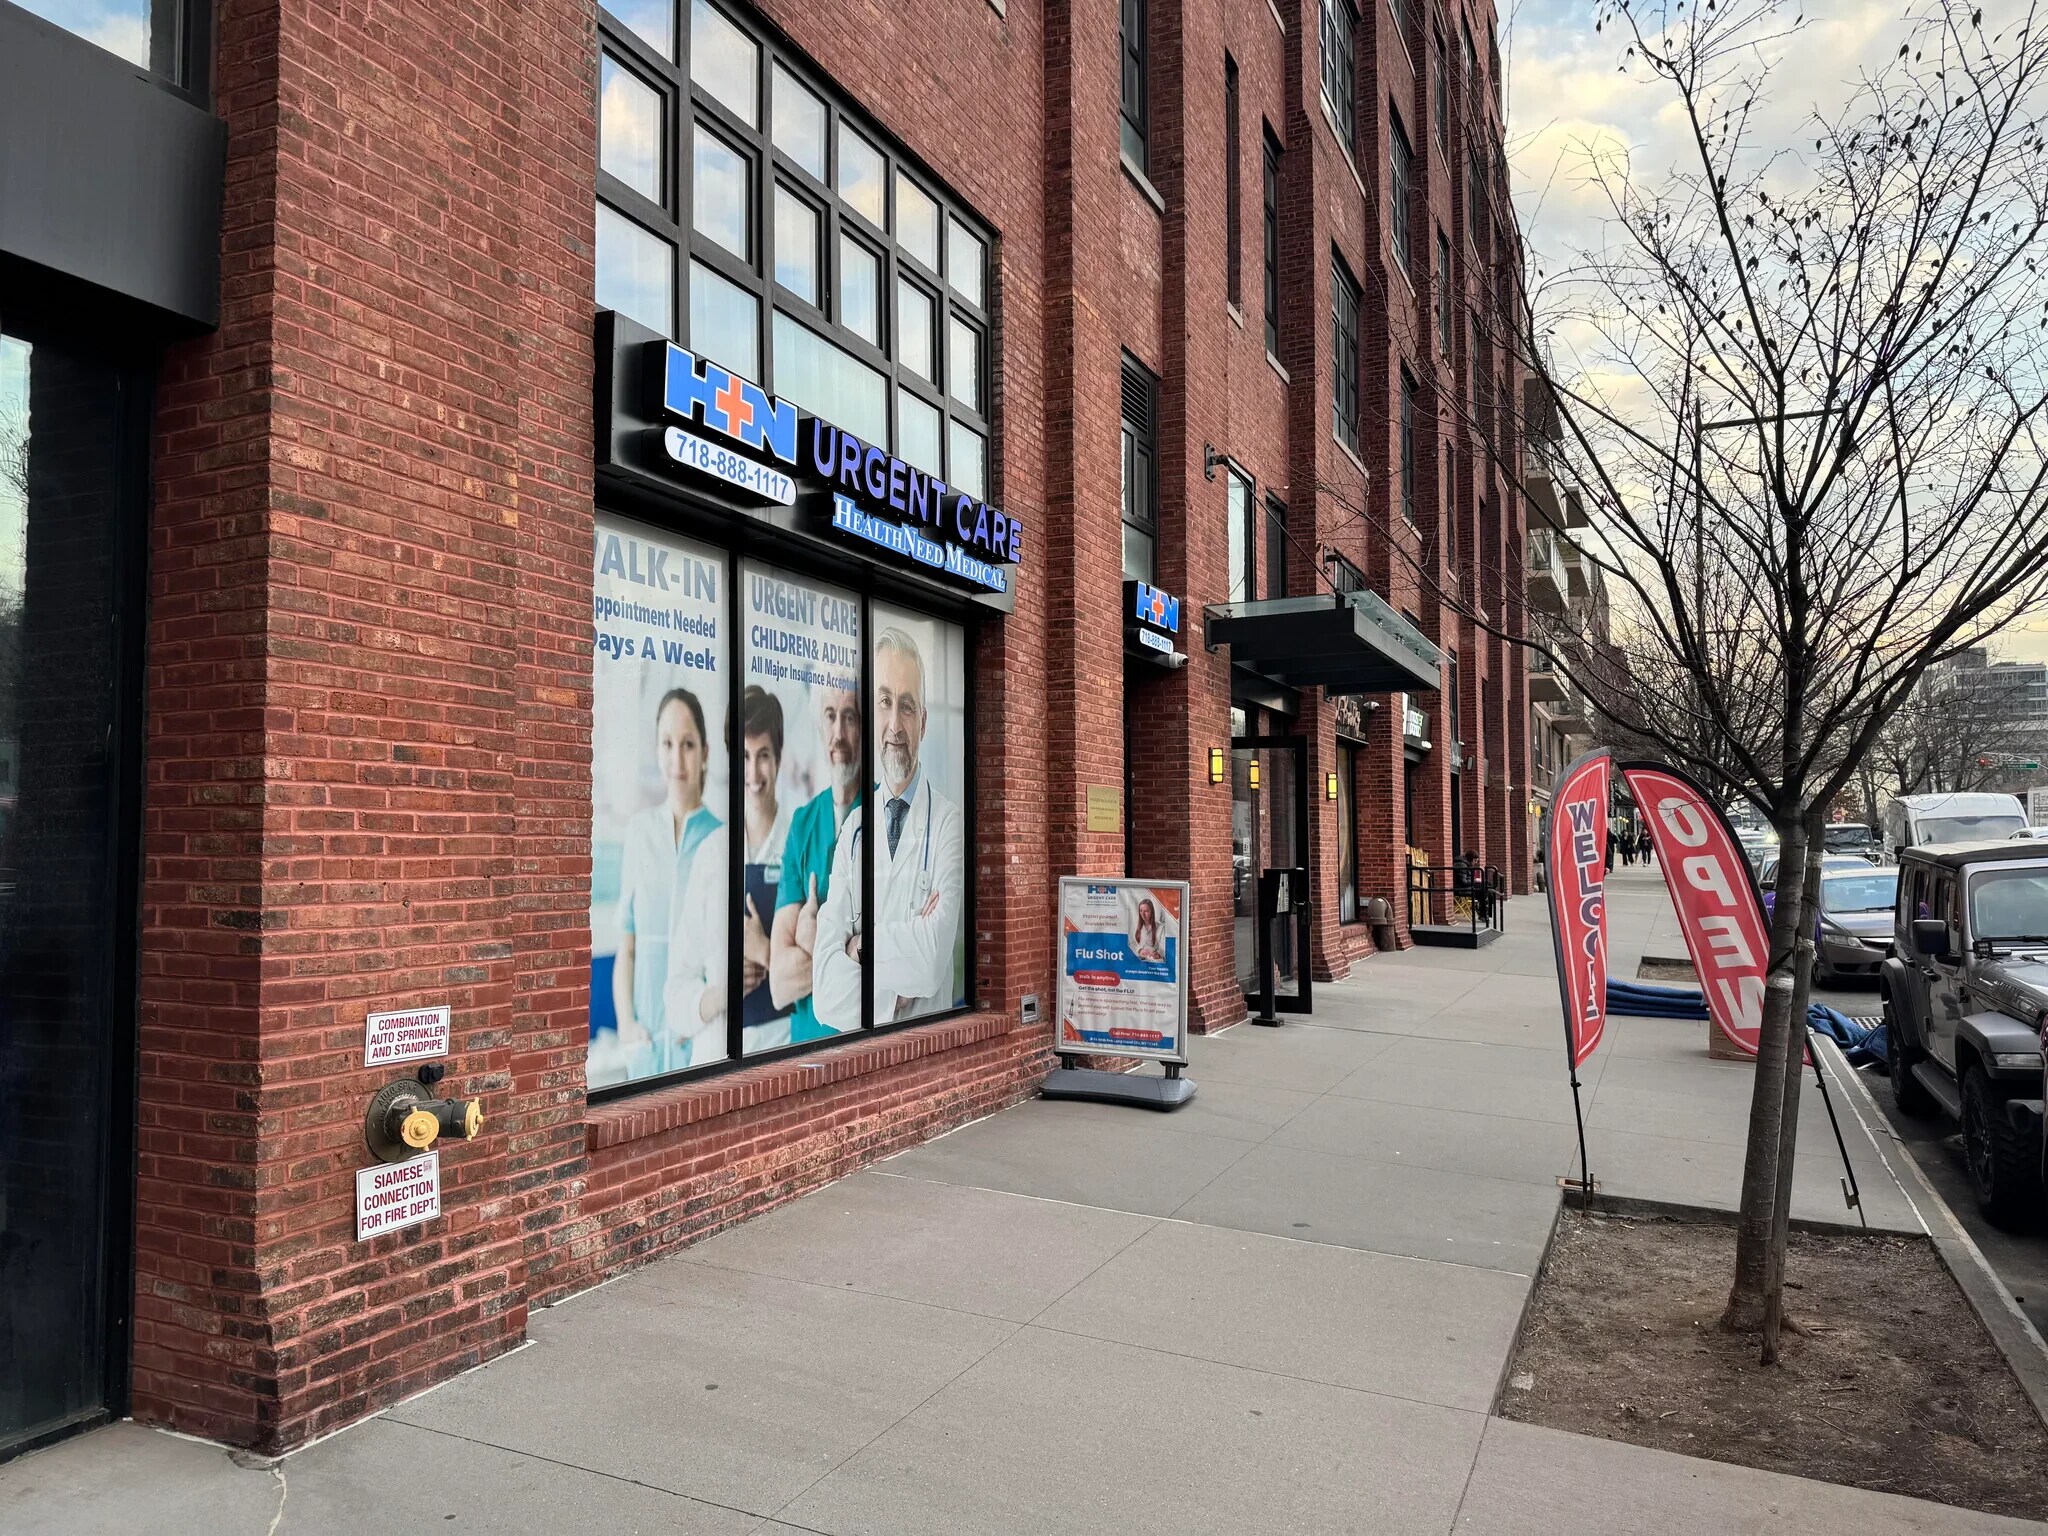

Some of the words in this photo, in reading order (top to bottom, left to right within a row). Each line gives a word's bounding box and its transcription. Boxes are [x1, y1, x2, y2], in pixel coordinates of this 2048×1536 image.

[676, 432, 789, 500] 718-888-1117
[813, 417, 948, 528] URGENT
[955, 494, 1023, 564] CARE
[594, 594, 671, 629] ppointment
[673, 608, 716, 639] Needed
[751, 574, 817, 626] URGENT
[820, 596, 857, 638] CARE
[641, 636, 657, 661] A
[662, 639, 716, 672] Week
[751, 624, 819, 661] CHILDREN&
[822, 641, 857, 669] ADULT
[751, 655, 763, 674] All
[764, 658, 789, 682] Major
[789, 663, 825, 686] Insurance
[1075, 948, 1095, 960] Flu
[1096, 948, 1124, 961] Shot
[370, 1031, 394, 1046] AUTO
[397, 1025, 446, 1042] SPRINKLER
[378, 1013, 440, 1031] COMBINATION
[371, 1045, 392, 1059] AND
[394, 1038, 443, 1056] STANDPIPE
[374, 1163, 423, 1190] SIAMESE
[364, 1179, 434, 1211] CONNECTION
[361, 1213, 382, 1231] FOR
[385, 1205, 408, 1224] FIRE
[410, 1197, 437, 1217] DEPT.
